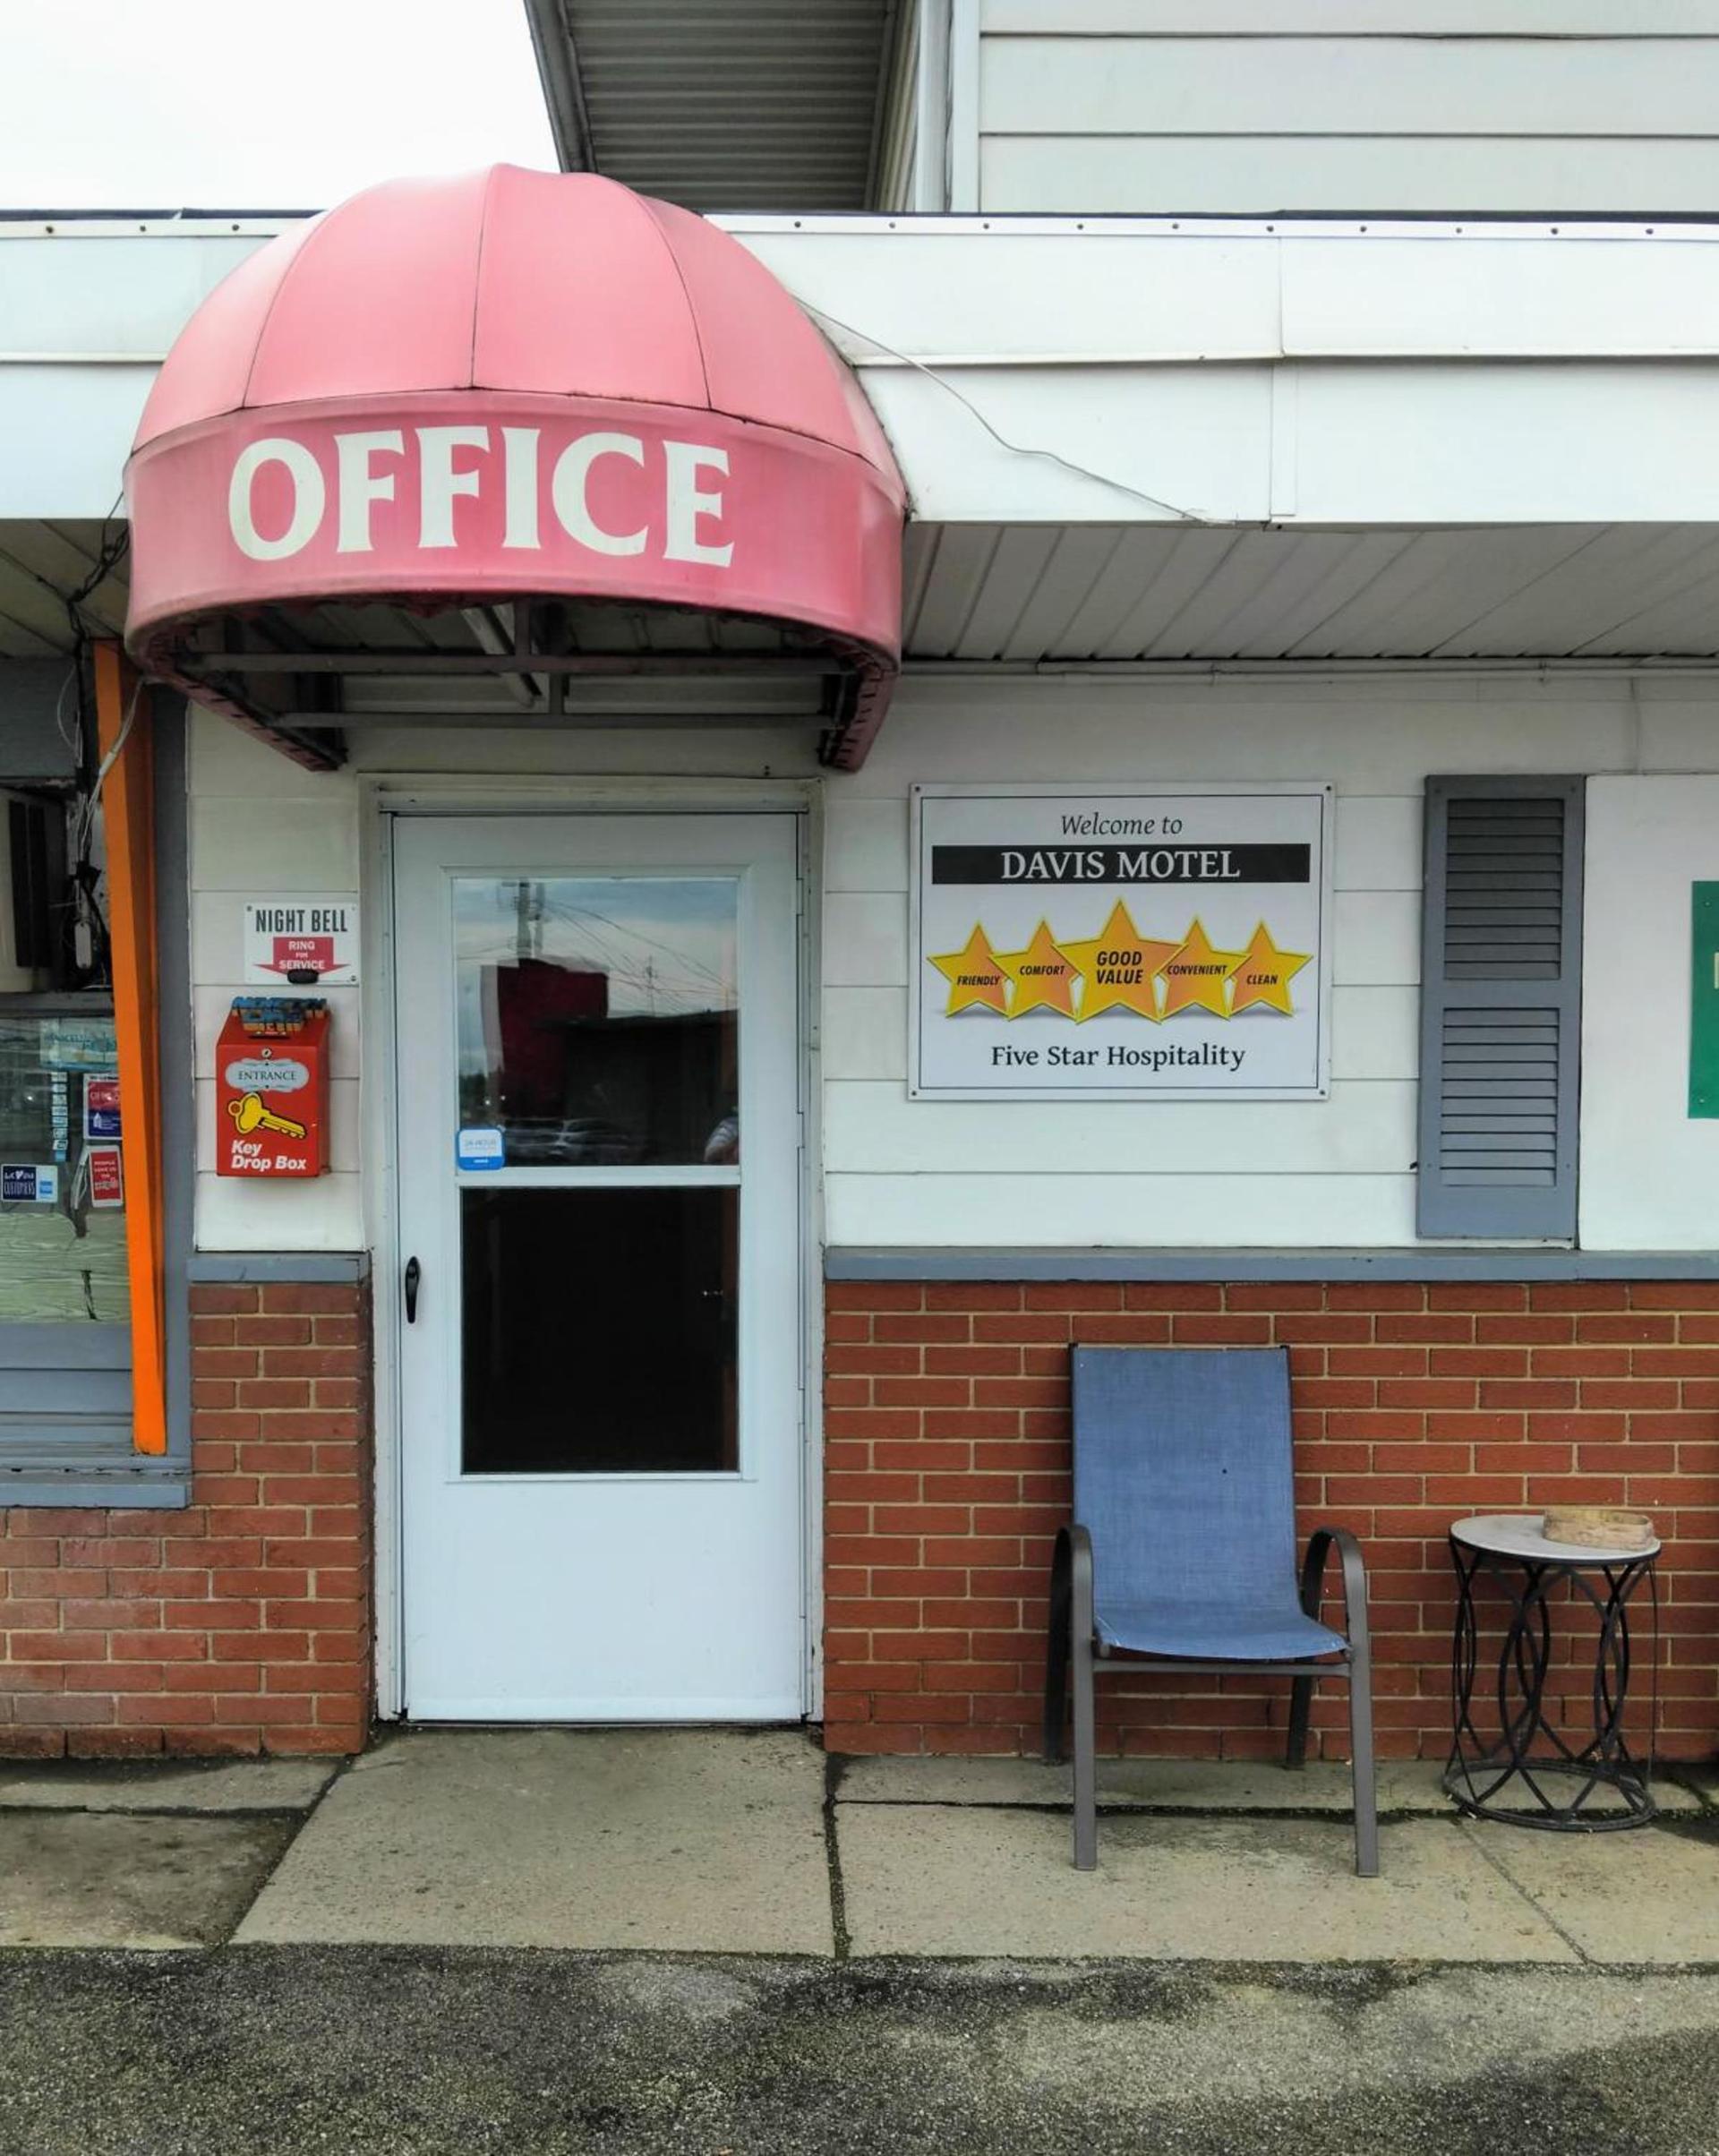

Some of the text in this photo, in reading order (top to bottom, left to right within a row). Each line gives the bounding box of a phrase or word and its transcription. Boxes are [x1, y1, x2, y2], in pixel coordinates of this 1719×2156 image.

[228, 425, 734, 568] OFFICE
[1061, 812, 1183, 835] Welcome to
[1001, 851, 1241, 879] DAVIS MOTEL
[255, 909, 347, 932] NIGHT BELL
[288, 940, 315, 951] RING
[278, 960, 325, 970] SERVICE
[1097, 951, 1142, 967] GOOD
[1019, 964, 1065, 976] COMFORT
[1096, 968, 1143, 985] VALUE
[1167, 964, 1227, 976] CONVENIENT
[956, 975, 1001, 987] FRIENDLY
[1246, 974, 1278, 986] CLEAN
[991, 1043, 1245, 1072] Five Star Hospitality
[238, 1070, 297, 1082] ENTRANCE
[231, 1139, 262, 1157] Key
[231, 1155, 306, 1172] Drop Box
